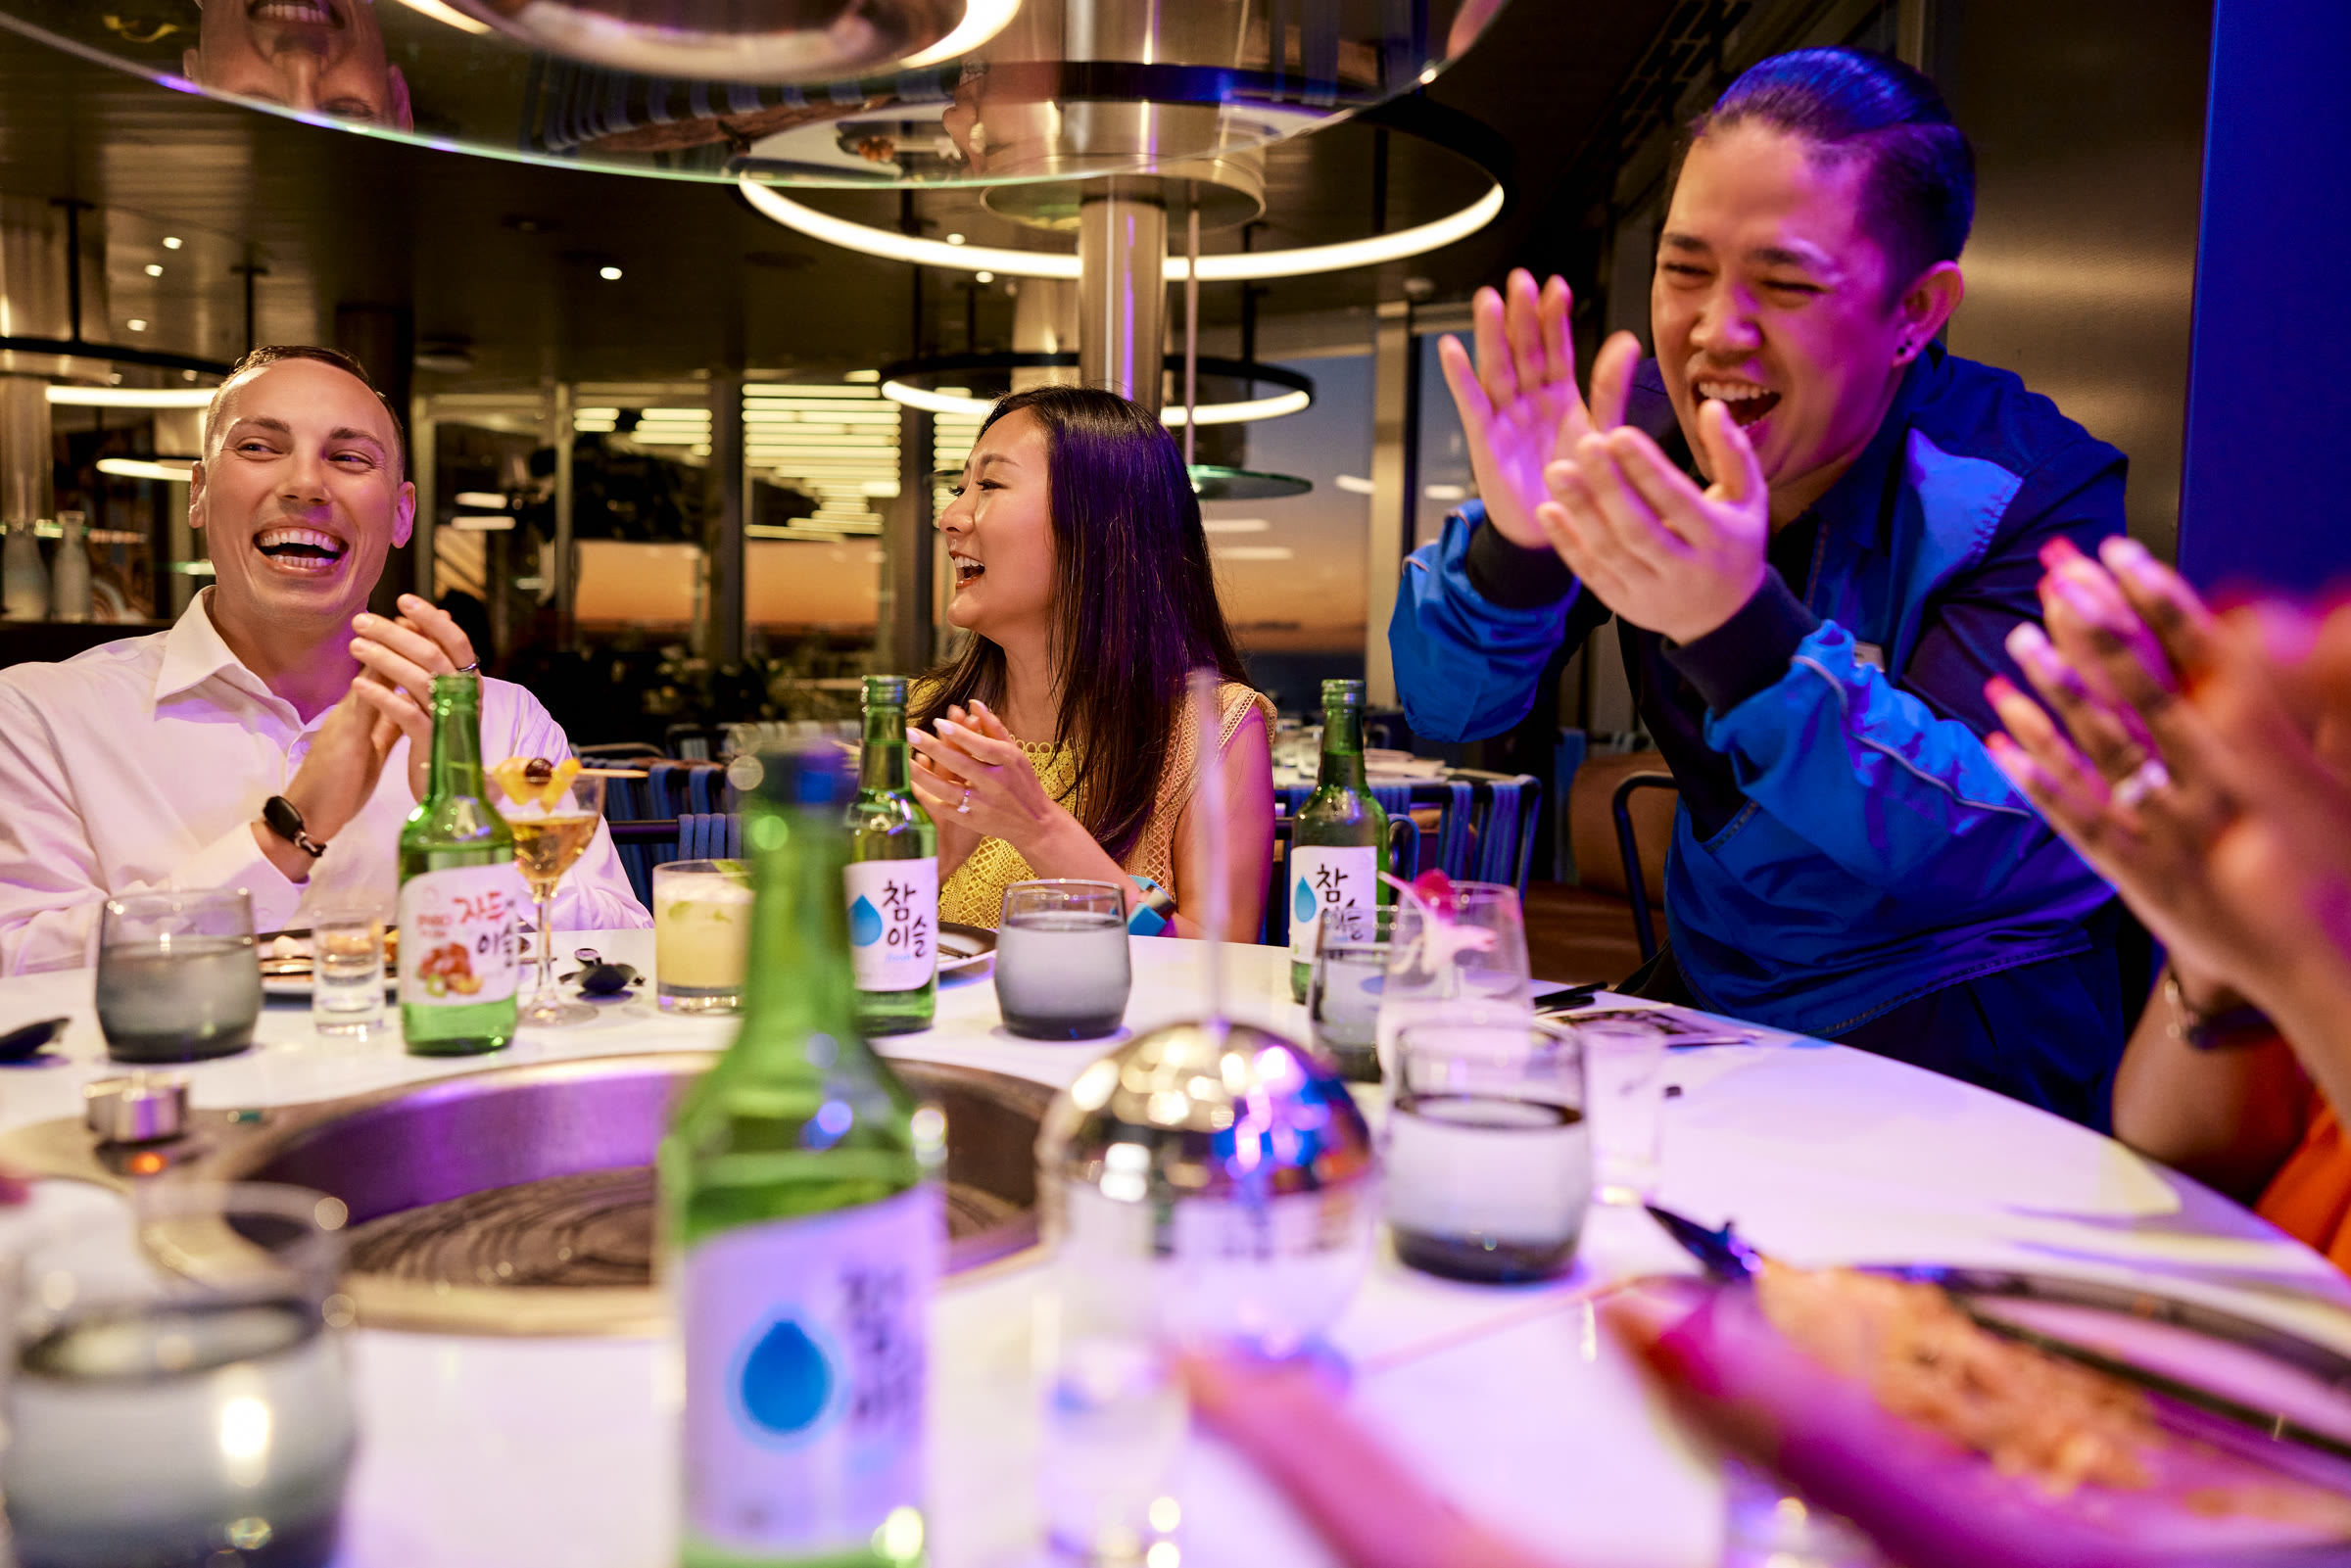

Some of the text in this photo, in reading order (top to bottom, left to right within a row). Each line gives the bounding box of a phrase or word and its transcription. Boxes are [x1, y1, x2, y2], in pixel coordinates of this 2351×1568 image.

[883, 879, 917, 922] 참
[1316, 864, 1349, 903] 참
[887, 915, 927, 958] 이슬
